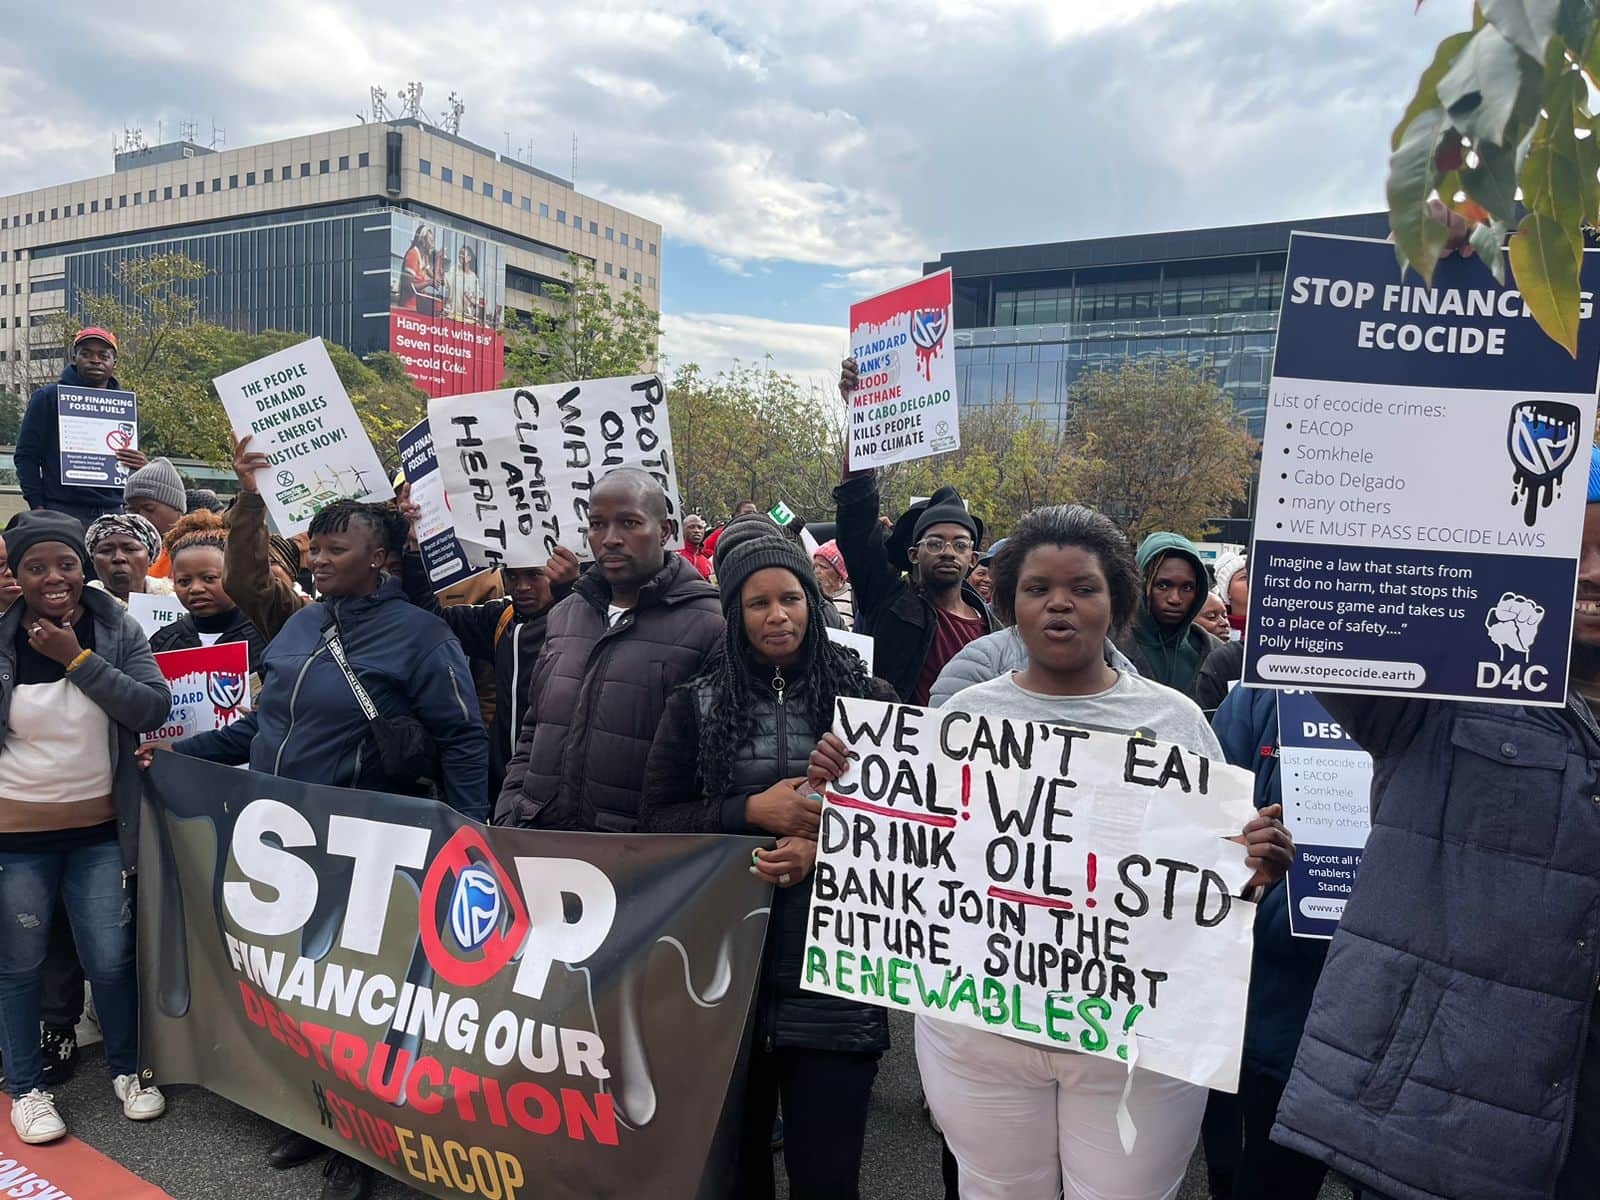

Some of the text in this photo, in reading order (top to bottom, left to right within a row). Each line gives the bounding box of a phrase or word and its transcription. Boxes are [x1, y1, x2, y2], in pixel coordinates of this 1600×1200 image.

[1290, 276, 1374, 309] STOP
[397, 317, 449, 337] Hang-out
[451, 328, 474, 343] with
[1357, 321, 1506, 356] ECOCIDE
[396, 335, 472, 359] Seven colours
[853, 333, 907, 359] STANDARD
[860, 353, 891, 375] ANK'S
[241, 363, 308, 399] THE PEOPLE
[60, 394, 133, 407] STOP FINANCING
[69, 403, 126, 415] FOSSIL FUELS
[255, 384, 306, 412] DEMAND
[853, 385, 902, 409] METHANE
[853, 389, 951, 425] IN CABO DELGADO
[1273, 392, 1447, 418] List of ecocide crimes:
[251, 395, 328, 434] RENEWABLES
[277, 416, 324, 443] ENERGY
[311, 427, 348, 450] NOW!
[600, 410, 625, 466] OU
[854, 414, 921, 441] KILLS PEOPLE
[1299, 419, 1354, 437] EACOP
[401, 445, 414, 463] STOP
[854, 440, 877, 457] AND
[881, 431, 924, 452] CLIMATE
[1296, 444, 1374, 464] Somkhele
[408, 452, 427, 473] FOSSIL
[114, 477, 128, 485] D4
[1294, 469, 1405, 492] Cabo Delgado
[451, 415, 508, 572] HEALTH
[500, 461, 533, 536] AND
[1291, 496, 1392, 515] many others
[1290, 519, 1546, 548] WE MUST PASS ECOCIDE LAWS
[1269, 555, 1472, 579] Imagine a law that starts from
[1264, 574, 1478, 602] first do no harm, that stops this
[152, 609, 173, 621] THE
[1262, 595, 1466, 619] dangerous game and takes us
[1261, 615, 1274, 628] to
[1278, 619, 1286, 629] a
[1289, 617, 1325, 635] place
[1328, 618, 1342, 632] of
[1259, 634, 1344, 654] Polly Higgins
[1268, 663, 1416, 682] www.stopecocide.earth
[1476, 661, 1549, 692] D4C
[172, 691, 204, 706] DARD
[168, 709, 186, 722] K'S
[145, 725, 184, 740] BLOOD
[837, 698, 924, 756] WE
[940, 712, 1090, 776] CAN'T
[1283, 756, 1301, 766] List
[1304, 756, 1314, 766] of
[1316, 757, 1355, 769] ecocide
[1303, 771, 1338, 782] EACOP
[1303, 785, 1353, 798] Somkhele
[985, 770, 1078, 842] WE
[1304, 800, 1369, 815] Cabo Delgad
[1305, 817, 1369, 829] many others
[821, 806, 1232, 928] DRINK OIL! STD
[1302, 853, 1340, 865] Boycott
[1341, 855, 1353, 865] all
[1308, 868, 1351, 879] enablers
[223, 798, 617, 1001] STOP
[1317, 882, 1352, 893] Standa
[815, 861, 1130, 964] BANK JOIN THE
[1308, 904, 1344, 913] www.st
[984, 933, 1169, 1009] SUPPORT
[223, 931, 612, 1080] FINANCING OUR
[806, 945, 1144, 1061] RENEWABLES!
[238, 980, 620, 1147] DESTRUCTION
[312, 1079, 525, 1200] #STOPEACOP
